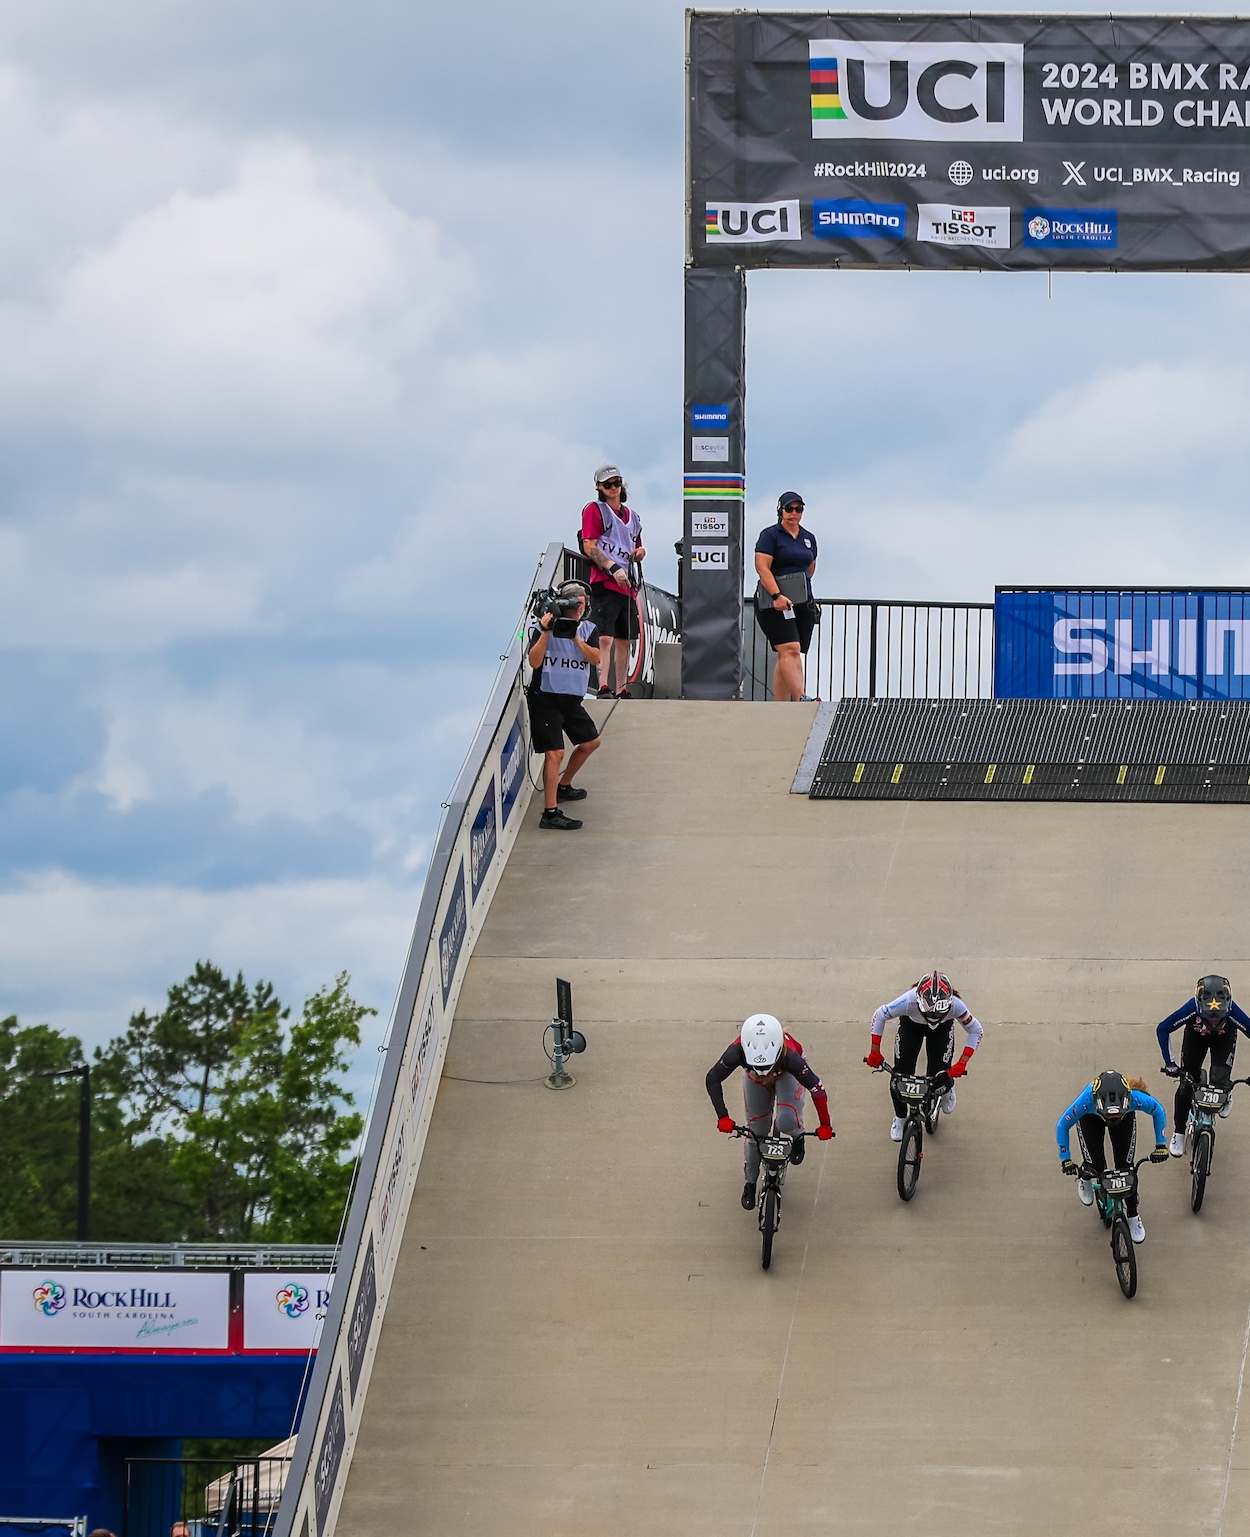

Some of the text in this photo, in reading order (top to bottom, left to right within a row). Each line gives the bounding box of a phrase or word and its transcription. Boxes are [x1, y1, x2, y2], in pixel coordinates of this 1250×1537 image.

[1041, 62, 1119, 90] 2024
[1129, 63, 1209, 91] BMX
[845, 57, 1005, 124] UCI
[1041, 98, 1165, 127] WORLD
[813, 161, 927, 178] #RockHill2024
[982, 166, 1040, 184] uci.org
[1093, 166, 1241, 187] UCI_BMX_Racing
[721, 207, 789, 236] UCI
[818, 211, 900, 228] SHIMANO
[931, 222, 997, 238] TISSOT
[697, 551, 726, 563] UCI
[544, 656, 589, 671] TV HOST
[905, 1082, 920, 1094] 721
[116, 1312, 175, 1320] CAROLINA
